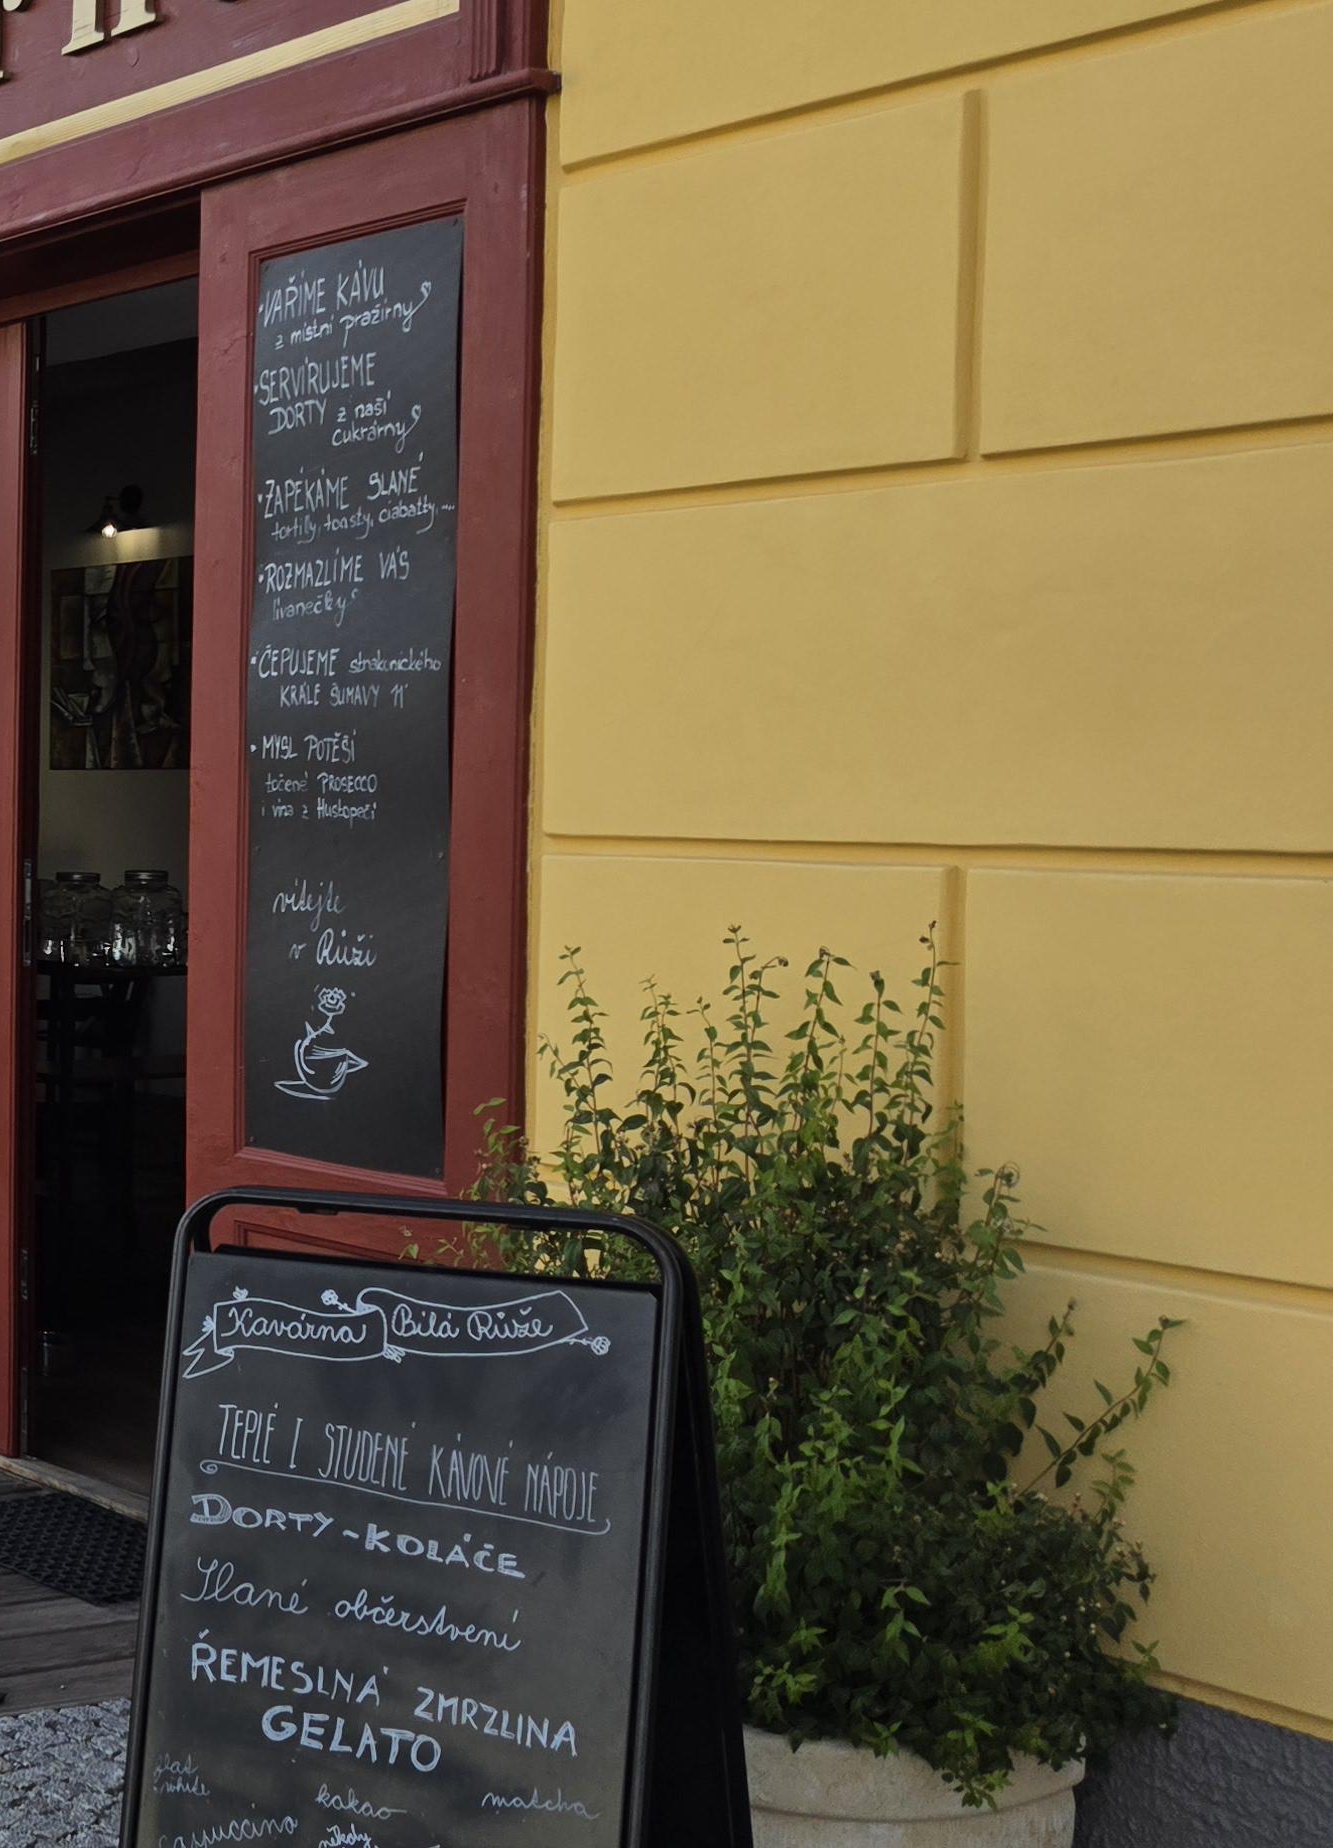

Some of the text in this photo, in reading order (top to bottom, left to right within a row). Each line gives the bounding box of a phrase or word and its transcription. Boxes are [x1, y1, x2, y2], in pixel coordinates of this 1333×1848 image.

[263, 259, 384, 328] VAŘÍME KÁVU
[268, 389, 391, 435] DORTY z naší
[331, 418, 406, 454] cukrárny
[264, 452, 424, 519] ZAPÉKÁME SLANÉ
[264, 546, 410, 594] ROZMAZLÍME VÁS
[258, 645, 340, 678] ČEPUJEME
[280, 681, 321, 708] KRÁLE
[330, 682, 380, 707] ŠUMAVY
[261, 729, 357, 763] MYSL POTĚŠÍ
[317, 771, 378, 794] PROSECCO
[289, 928, 378, 967] v Růži
[220, 1306, 367, 1343] Kavárna
[466, 1306, 554, 1342] Růže
[218, 1402, 600, 1524] TEPLÉ I STUDENÉ KÁVOVÉ NÁPOJE
[180, 1556, 522, 1652] Slané občerstvení
[190, 1627, 579, 1759] ŘEMESLNÁ ZMRZLINA
[260, 1703, 442, 1774] GELATO
[315, 1783, 602, 1821] kakao matcha
